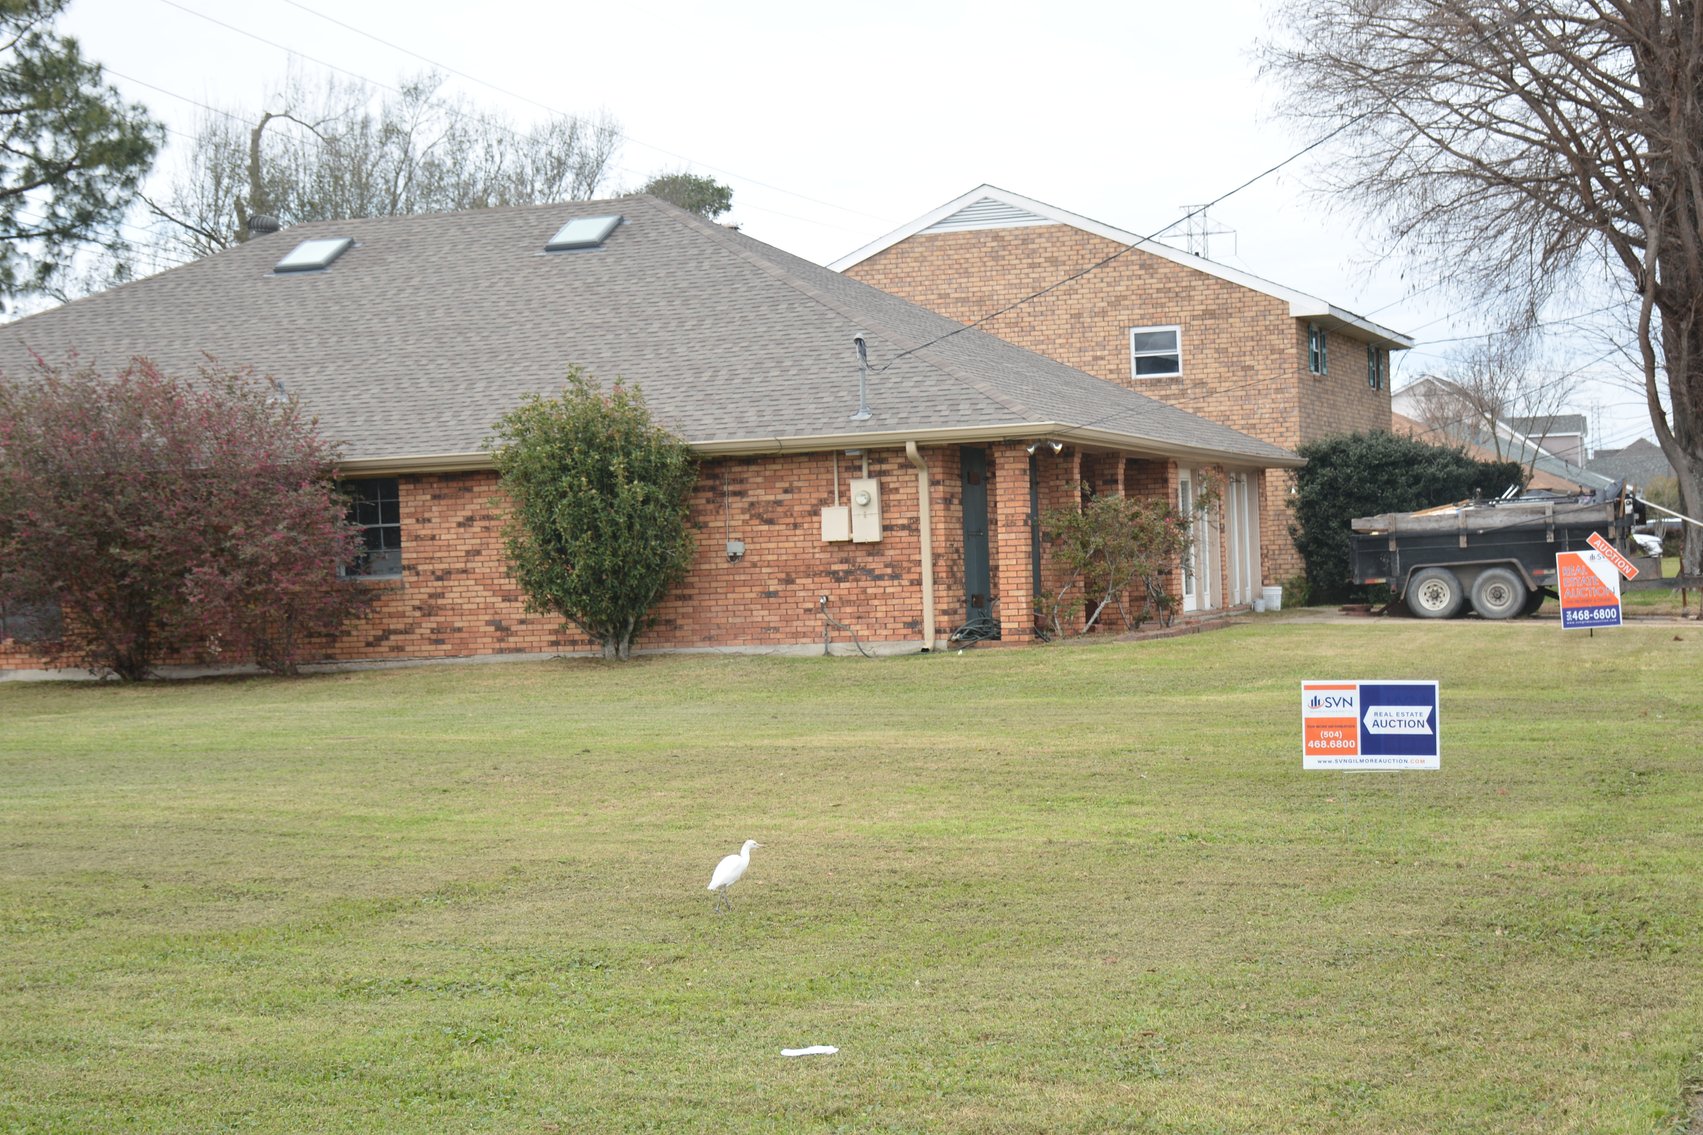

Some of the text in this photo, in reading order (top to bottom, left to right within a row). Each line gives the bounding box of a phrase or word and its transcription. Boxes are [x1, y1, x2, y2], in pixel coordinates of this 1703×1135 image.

[1593, 540, 1632, 574] AUCTION
[1562, 565, 1588, 576] REAL
[1563, 575, 1599, 587] ESTATE
[1564, 586, 1616, 598] AUCTION
[1572, 608, 1617, 621] 468-6800
[1324, 696, 1354, 708] SVN
[1372, 719, 1425, 728] AUCTION
[1320, 731, 1343, 739] (504)
[1308, 740, 1356, 748] 468.6800
